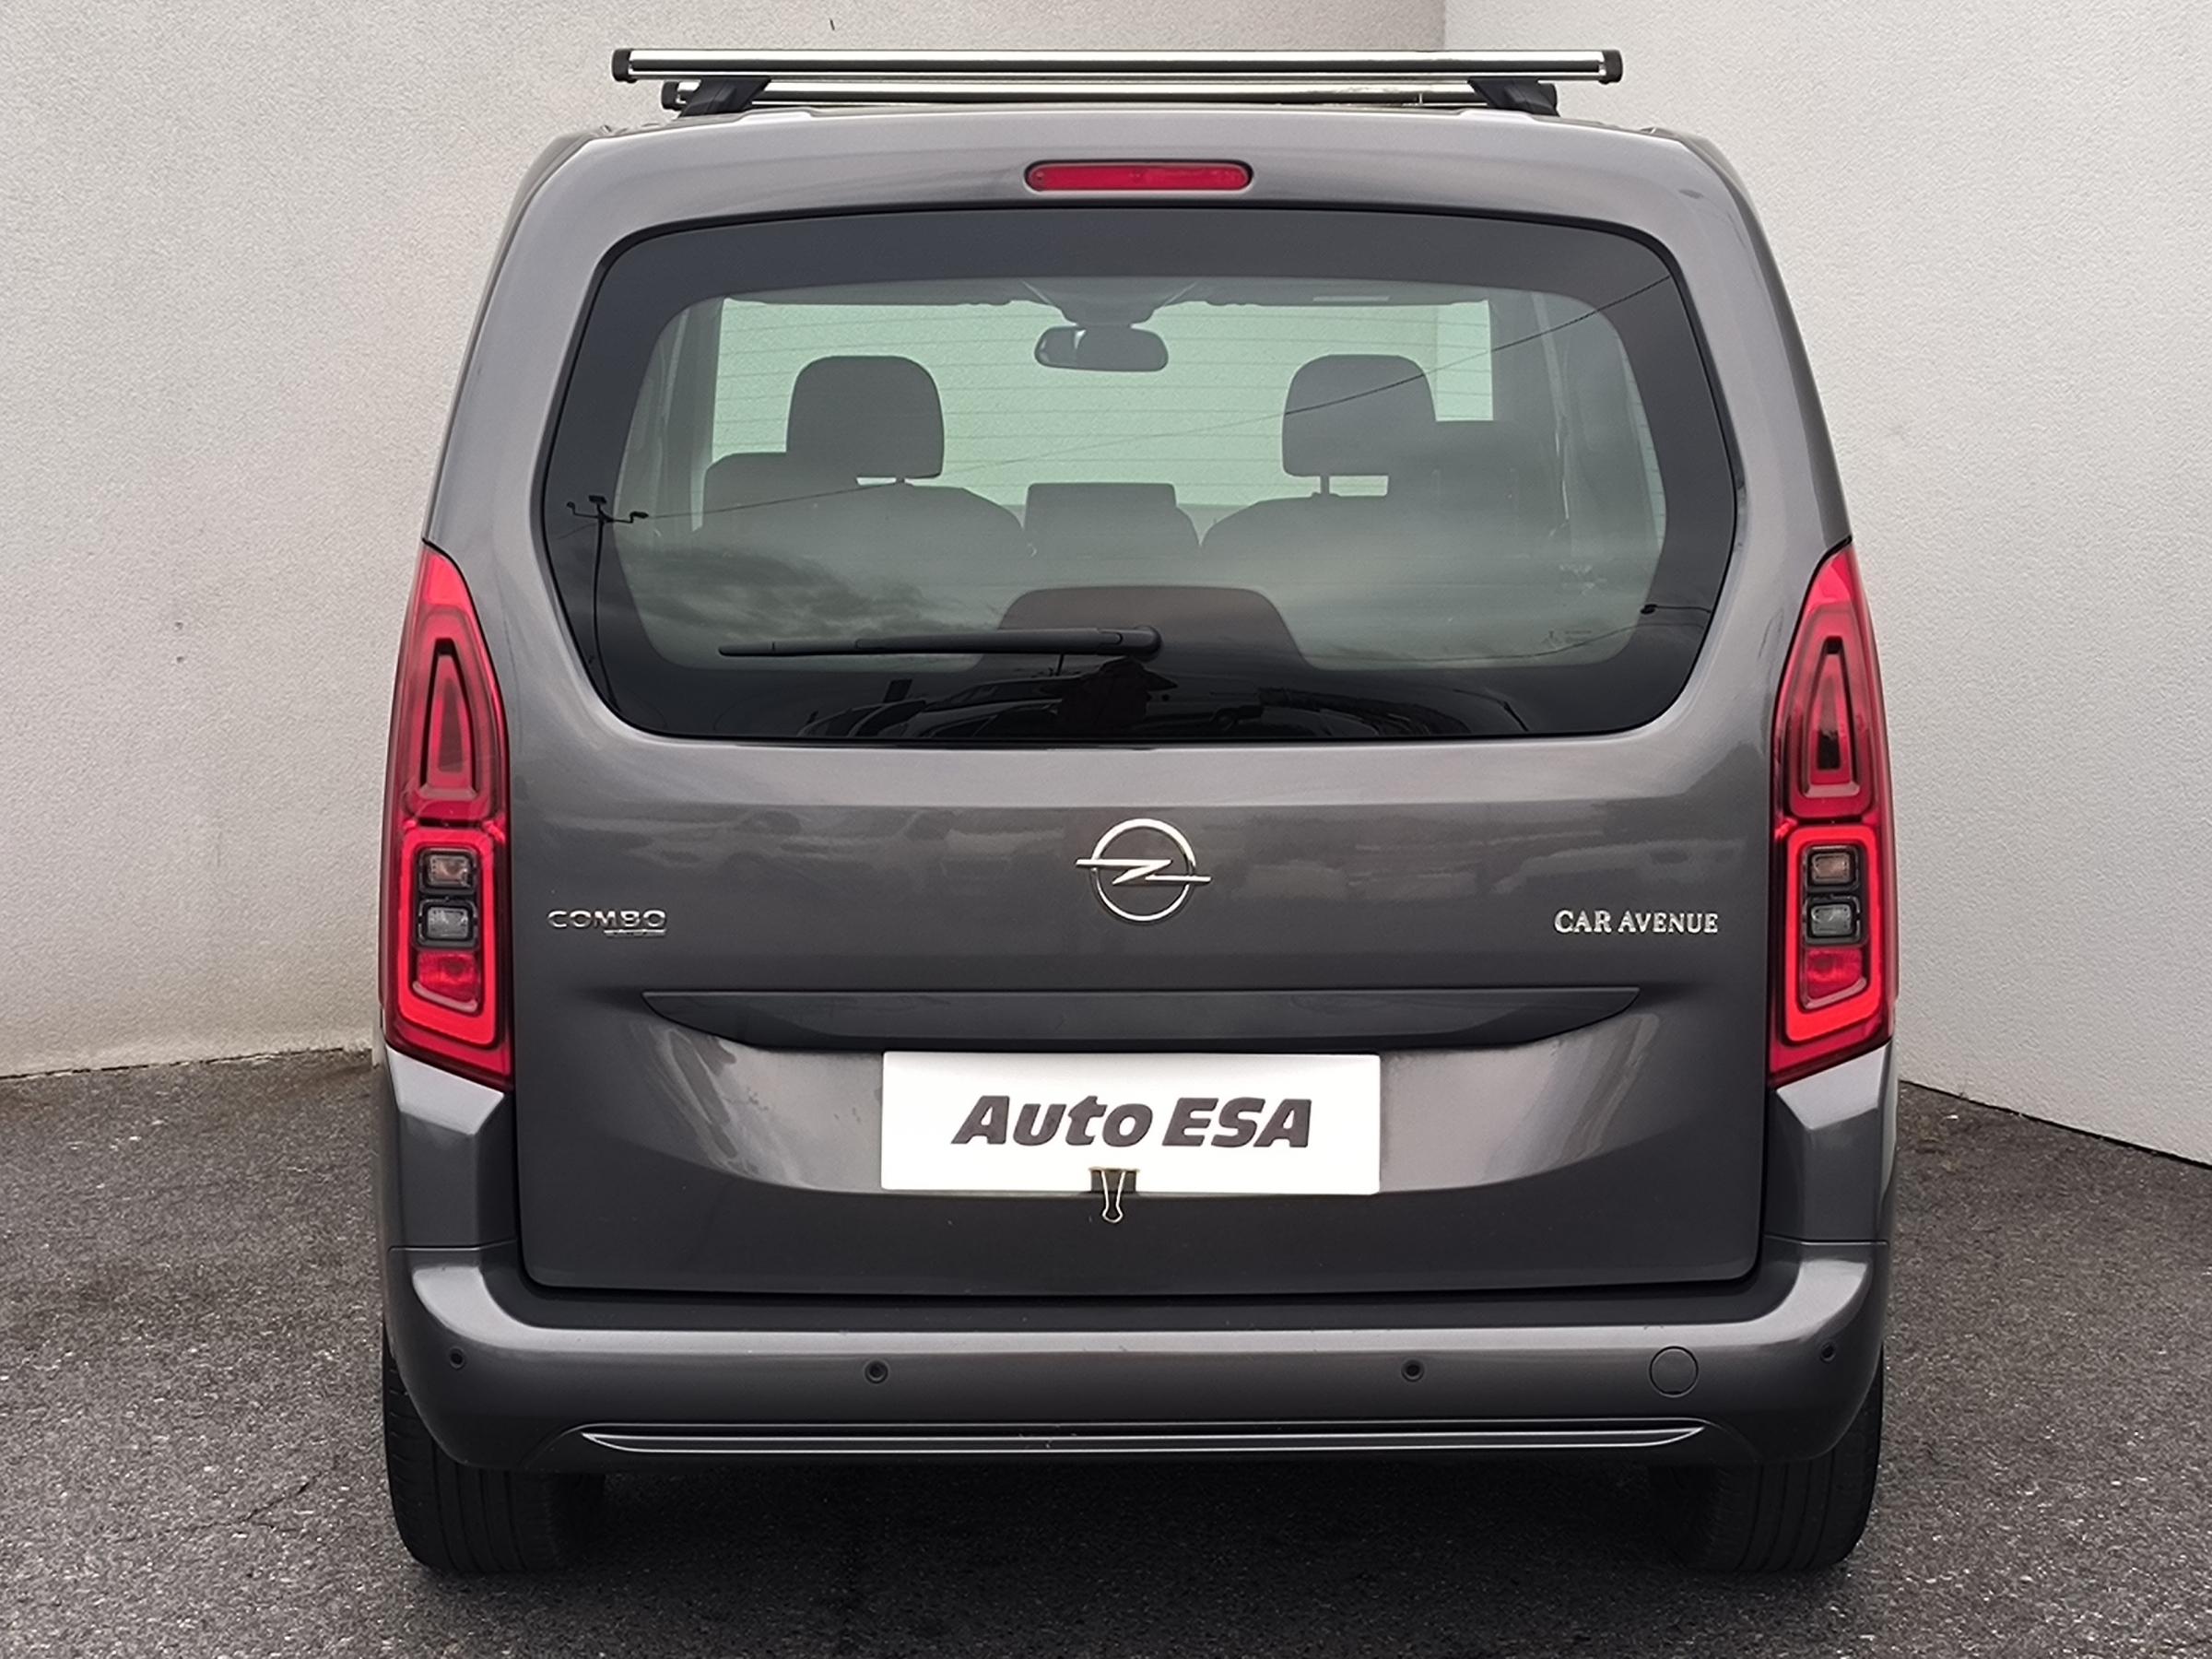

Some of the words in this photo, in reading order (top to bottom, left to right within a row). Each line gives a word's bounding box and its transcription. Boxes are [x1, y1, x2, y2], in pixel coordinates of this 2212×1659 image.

[547, 910, 666, 928] COMBO
[1554, 909, 1612, 934] CAR
[1618, 910, 1719, 934] AVENUE
[950, 1094, 1154, 1147] Auto
[1161, 1096, 1312, 1148] ESA
